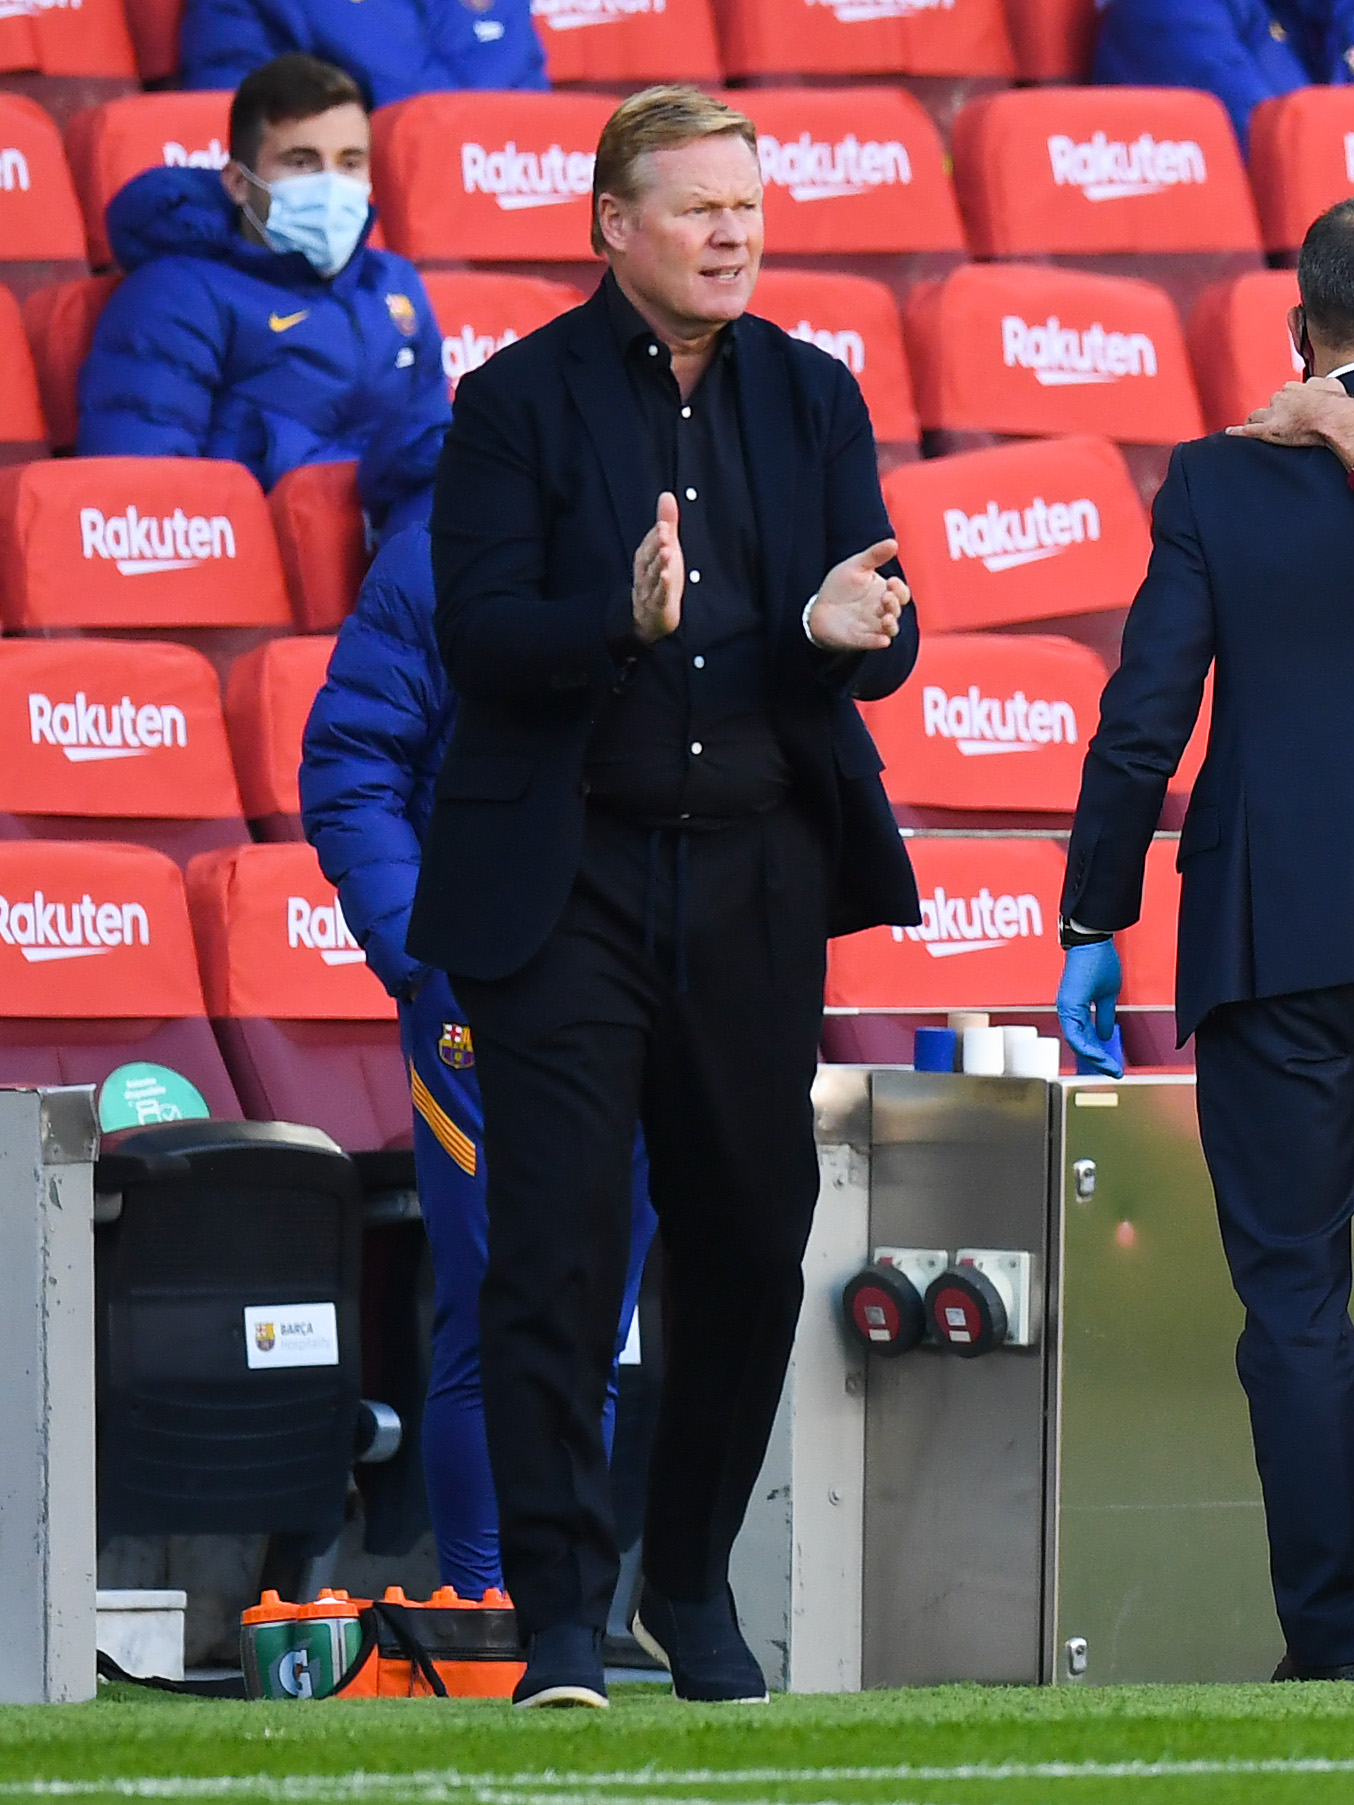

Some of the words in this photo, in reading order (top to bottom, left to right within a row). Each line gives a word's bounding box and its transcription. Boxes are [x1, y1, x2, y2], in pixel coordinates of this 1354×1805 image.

[461, 141, 595, 193] Rakute
[756, 132, 912, 185] Rakuten
[1047, 131, 1206, 185] Rakuten
[1002, 316, 1157, 376] Rakuten
[80, 505, 236, 558] Rakuten
[944, 497, 1100, 560] Rakuten
[28, 691, 187, 747] Rakuten
[922, 685, 1078, 744] Rakuten
[892, 887, 1043, 942] akuten
